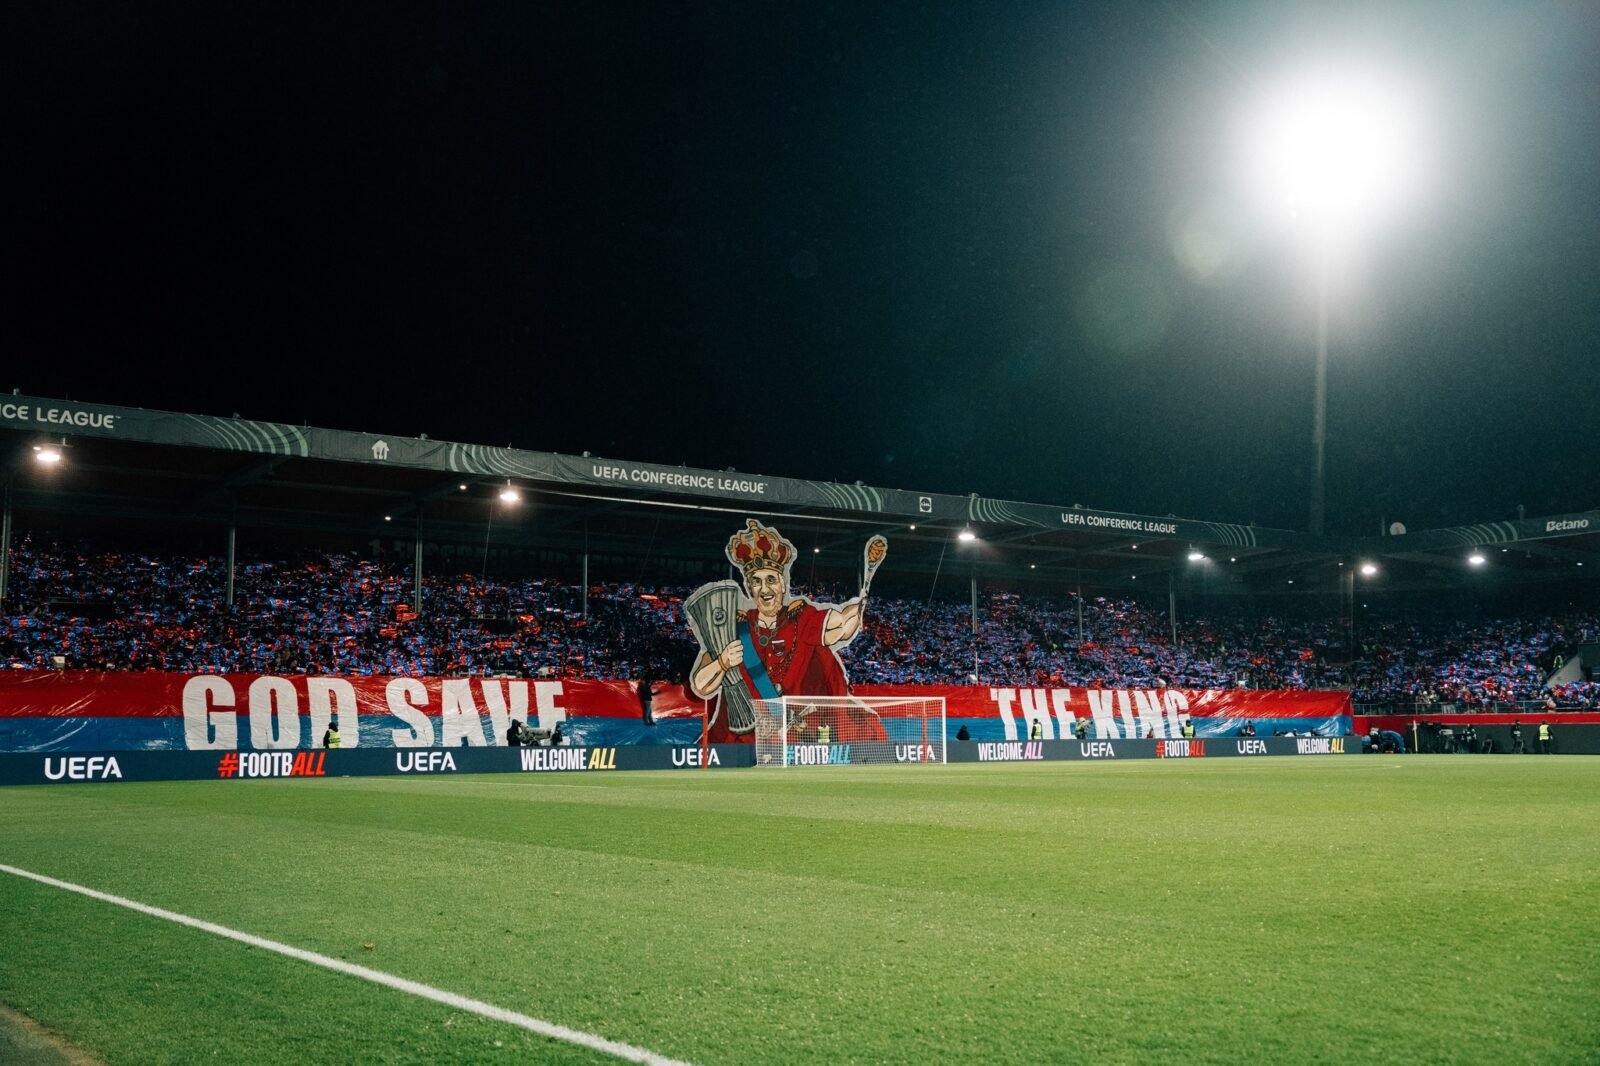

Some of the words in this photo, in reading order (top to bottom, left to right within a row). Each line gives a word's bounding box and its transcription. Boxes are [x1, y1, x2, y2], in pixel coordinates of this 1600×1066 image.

[36, 407, 114, 429] LEAGUE
[593, 465, 628, 481] UEFA
[631, 469, 714, 488] CONFERENCE
[718, 478, 765, 494] LEAGUE
[1062, 513, 1085, 525] UEFA
[1087, 516, 1142, 530] CONFERENCE
[1145, 521, 1176, 533] LEAGUE
[1546, 519, 1588, 531] Betano
[182, 674, 359, 750] GOD
[385, 677, 570, 747] SAVE
[990, 688, 1075, 740] THE
[1087, 689, 1191, 739] KING
[787, 744, 851, 765] #FOOTBALL
[895, 744, 936, 761] UEFA
[978, 742, 1023, 761] WELCOME
[1024, 741, 1043, 760] ALL
[1080, 741, 1115, 758] UEFA
[1156, 739, 1205, 758] #FOOTBALL
[1237, 739, 1267, 755] UEFA
[1297, 738, 1330, 754] WELCOME
[1330, 737, 1345, 753] ALL
[217, 751, 326, 778] #FOOTBALL
[395, 751, 457, 772] UEFA
[520, 748, 587, 771] WELCOME
[587, 747, 616, 770] ALL
[672, 747, 721, 766] UEFA
[44, 755, 122, 780] UEFA
